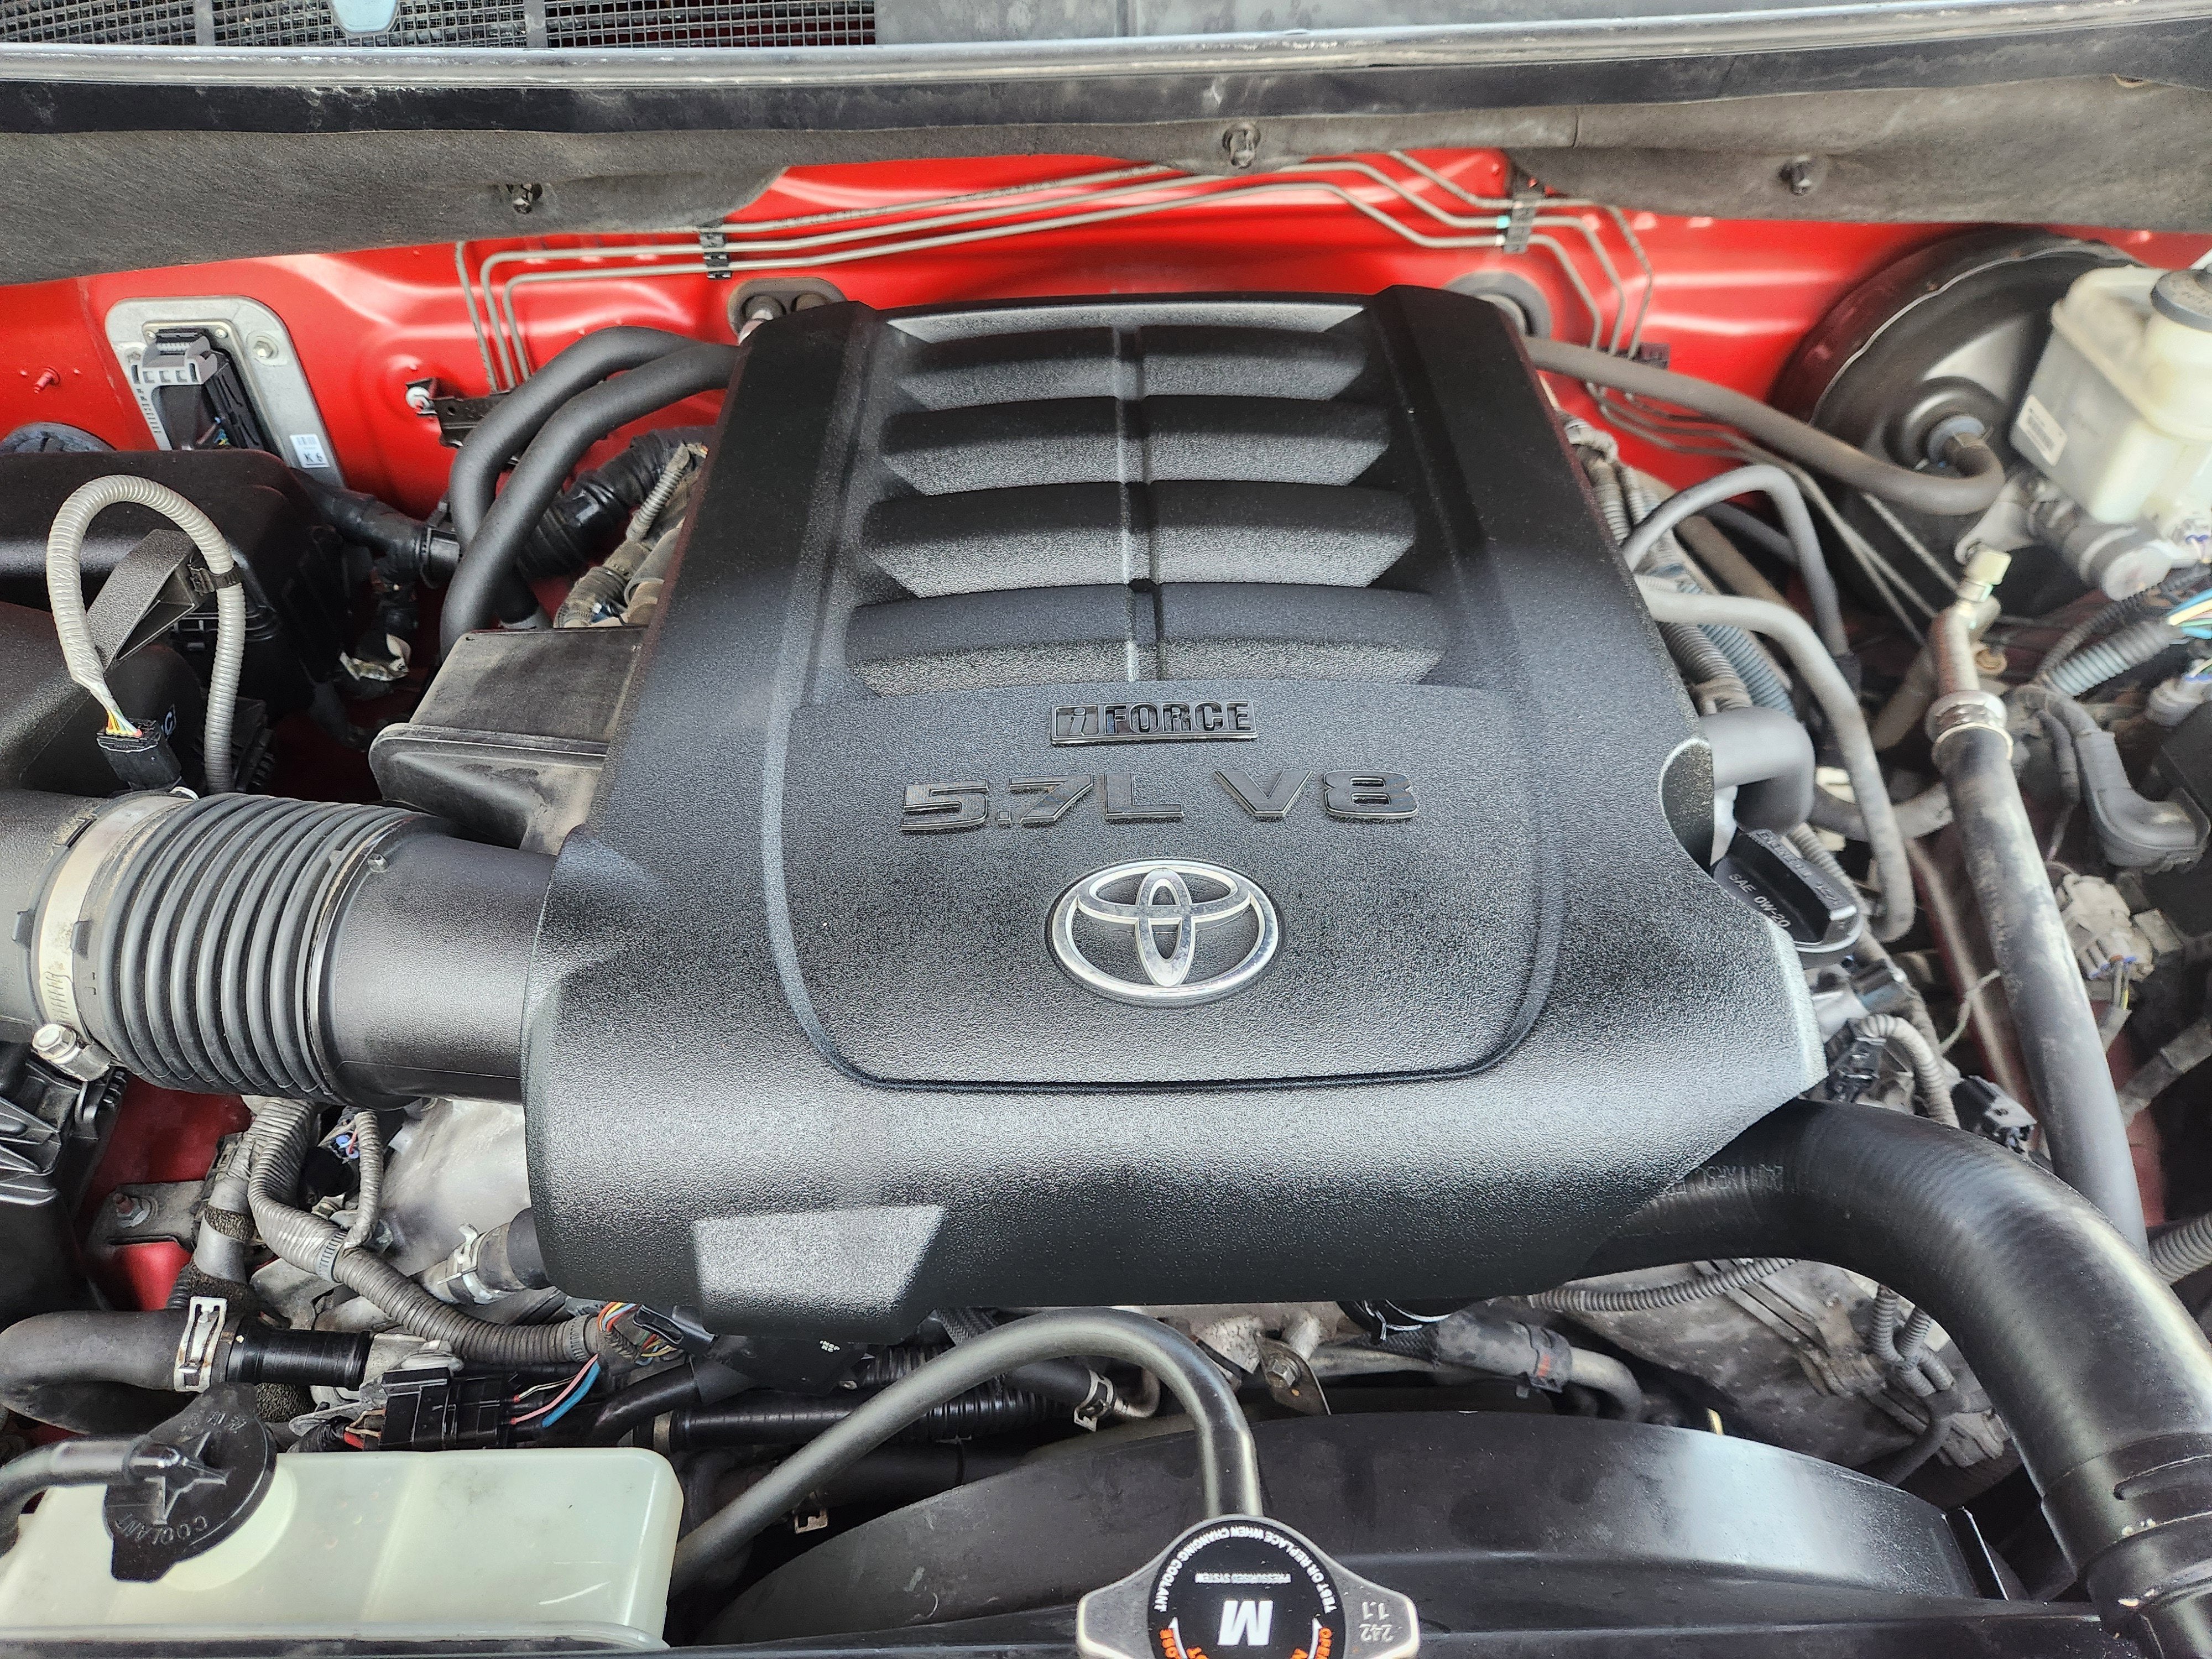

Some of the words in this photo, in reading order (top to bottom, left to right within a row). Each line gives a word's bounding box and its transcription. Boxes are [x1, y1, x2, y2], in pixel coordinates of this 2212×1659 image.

[1105, 701, 1254, 737] FORCE
[901, 773, 1186, 831] 5.7L
[1218, 770, 1418, 820] V8
[1729, 874, 1756, 893] SAE
[1754, 896, 1791, 927] 0W-20
[114, 1514, 208, 1545] COOLANT
[1176, 1527, 1230, 1562] CHANGING
[1230, 1526, 1264, 1540] WHEN
[1264, 1531, 1313, 1568] REPLACE
[1154, 1559, 1183, 1612] COOLANT
[1194, 1572, 1231, 1584] SYSTEM
[1306, 1563, 1324, 1583] OR
[1316, 1583, 1338, 1614] TEST
[1217, 1600, 1274, 1646] M
[1359, 1623, 1393, 1642] 242
